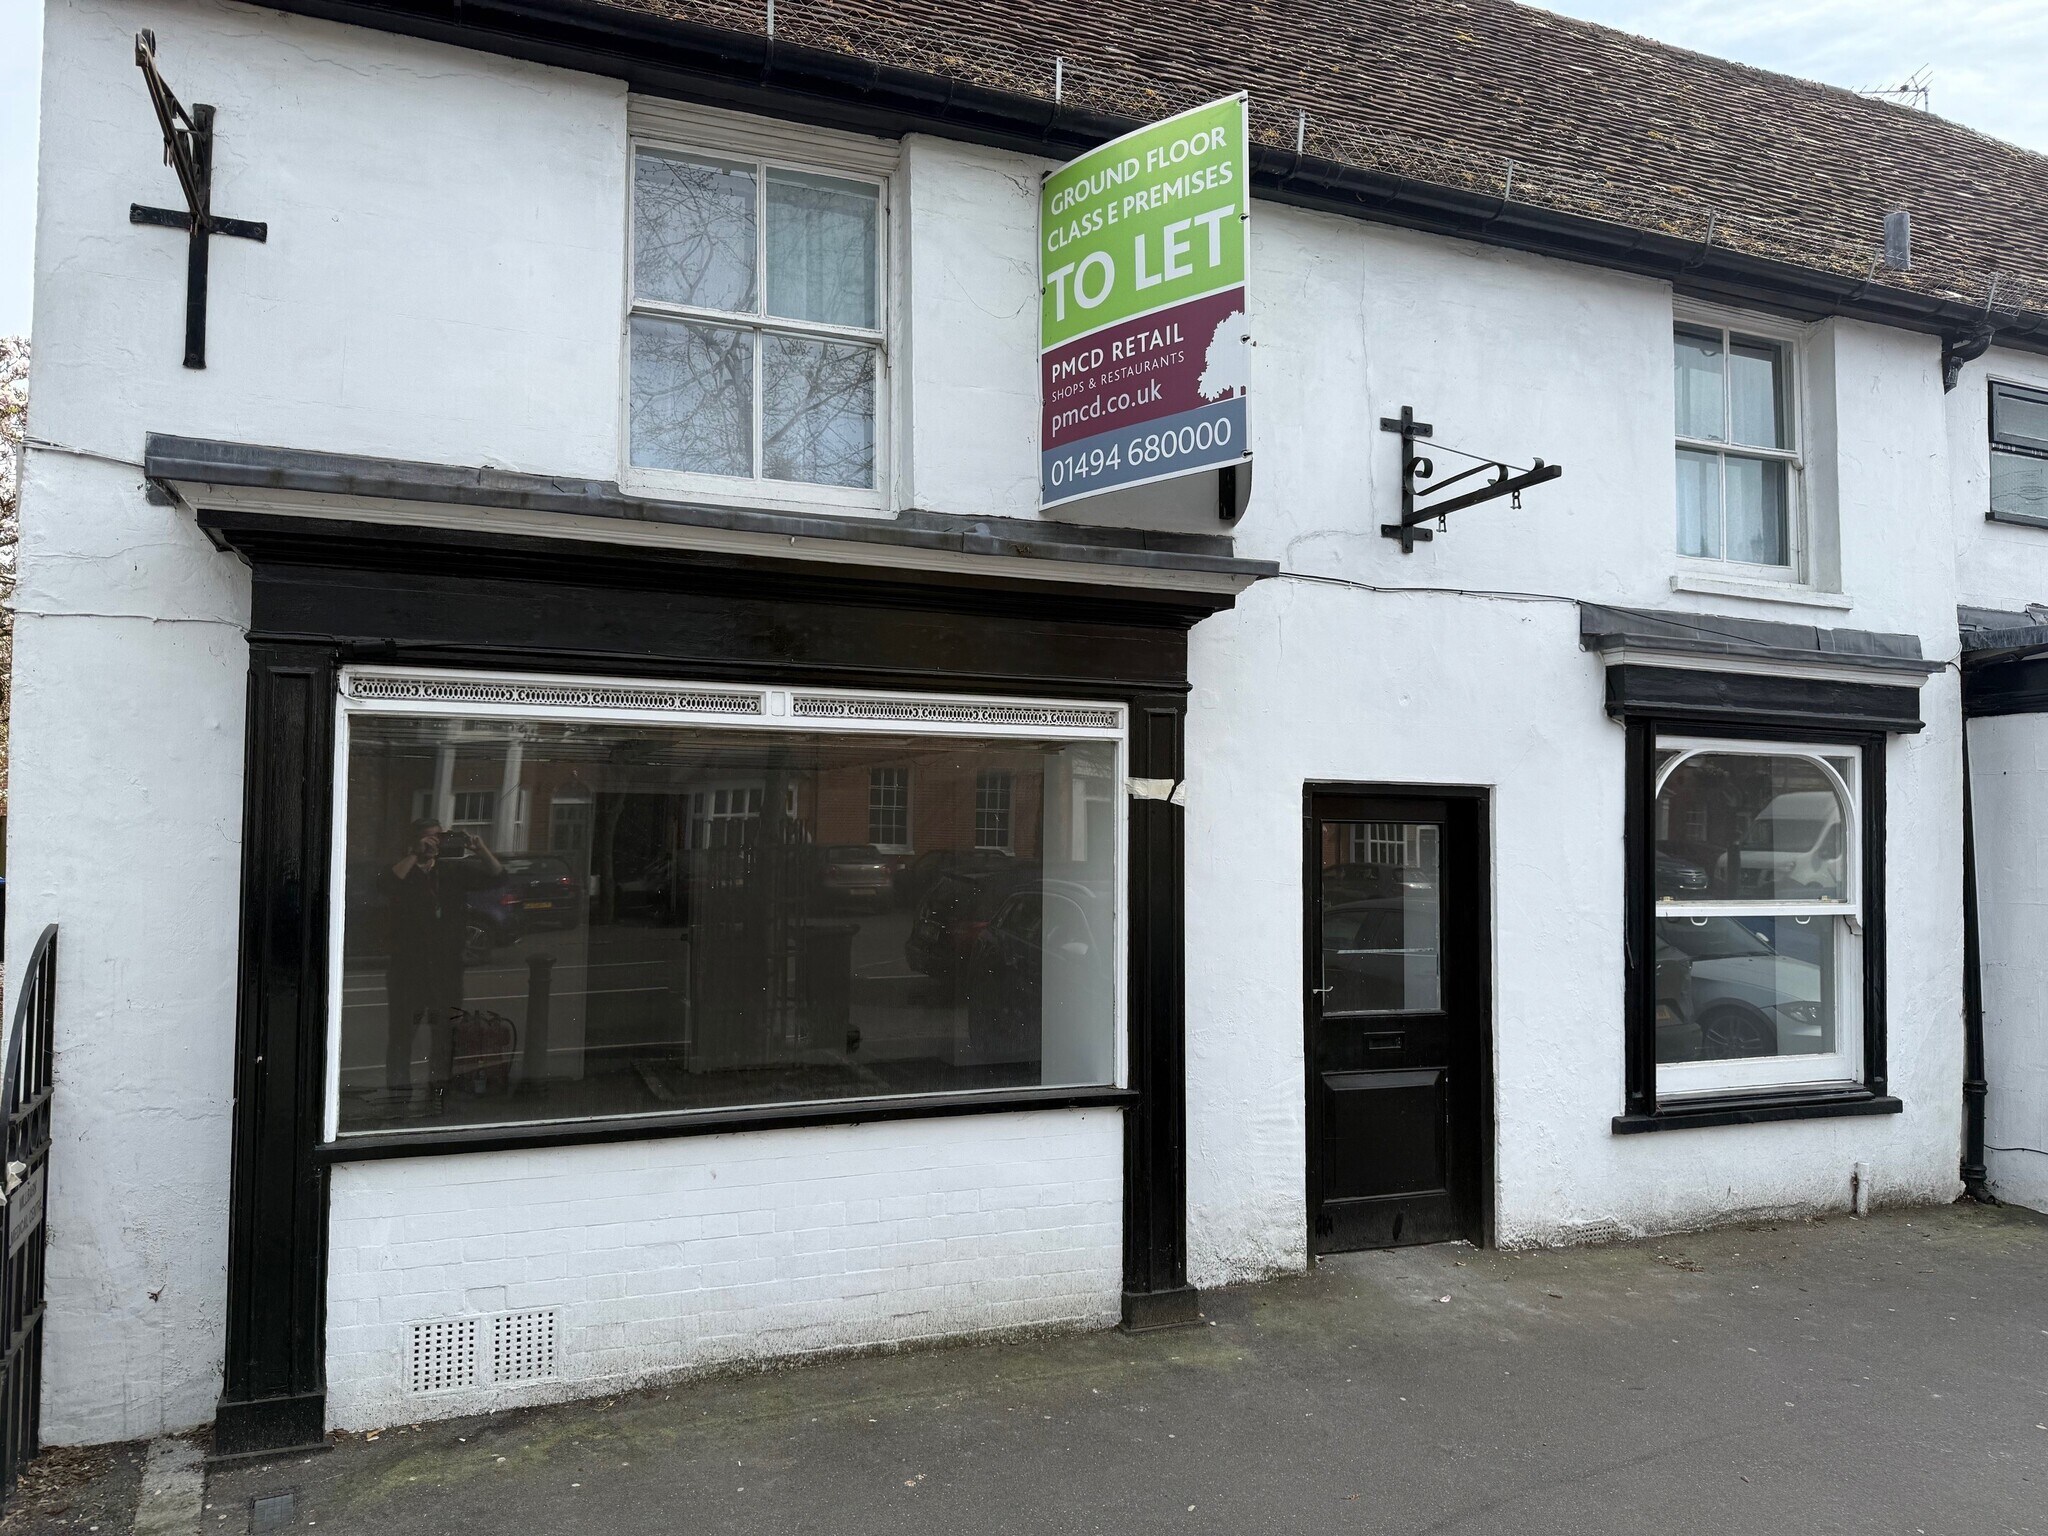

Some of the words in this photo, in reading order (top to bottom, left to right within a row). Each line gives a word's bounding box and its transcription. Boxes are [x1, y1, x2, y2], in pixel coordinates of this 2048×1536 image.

[1051, 158, 1140, 215] GROUND
[1147, 127, 1227, 173] FLOOR
[1048, 209, 1103, 252] CLASS
[1108, 201, 1119, 225] E
[1124, 161, 1233, 219] PREMISES
[1047, 250, 1115, 322] TO
[1135, 204, 1236, 291] LET
[1052, 348, 1104, 383] PMCD
[1112, 323, 1184, 362] RETAIL
[1052, 382, 1084, 403] SHOPS
[1088, 378, 1097, 390] &
[1101, 350, 1185, 386] RESTAURANTS
[1052, 379, 1163, 438] pmcd.co.uk
[1052, 443, 1121, 486] 01494
[1127, 417, 1232, 466] 680000
[10, 1213, 29, 1244] MEDICAL
